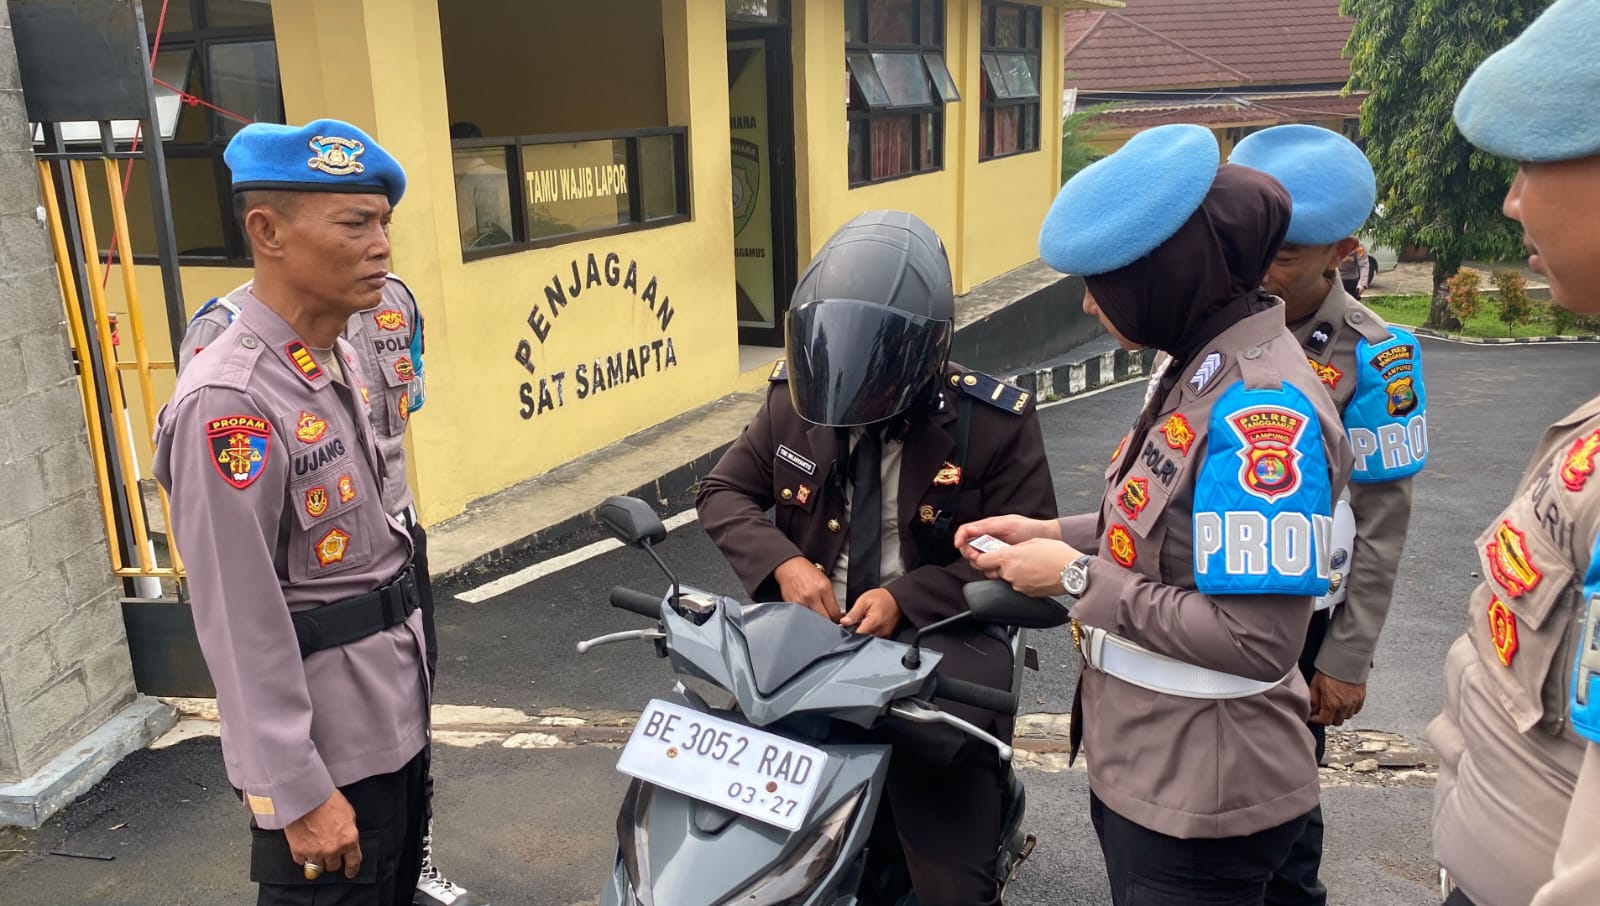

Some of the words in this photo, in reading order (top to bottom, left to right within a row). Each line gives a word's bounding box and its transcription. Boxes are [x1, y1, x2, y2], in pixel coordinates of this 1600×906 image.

[526, 169, 558, 204] TAMU
[560, 167, 593, 201] WAJIB
[595, 164, 627, 195] LAPOR
[514, 252, 675, 374] PENJAGAAN
[519, 371, 566, 420] SAT
[575, 338, 677, 399] SAMAPTA
[212, 418, 265, 430] PROPAM
[1239, 413, 1297, 426] POLRES
[1244, 420, 1294, 431] TANGGAMUS
[1250, 432, 1289, 441] LAMPUNG
[295, 438, 345, 475] UJANG
[1141, 441, 1178, 487] POLRI
[643, 710, 681, 743] BE
[682, 723, 749, 766] 3052
[757, 745, 813, 785] RAD
